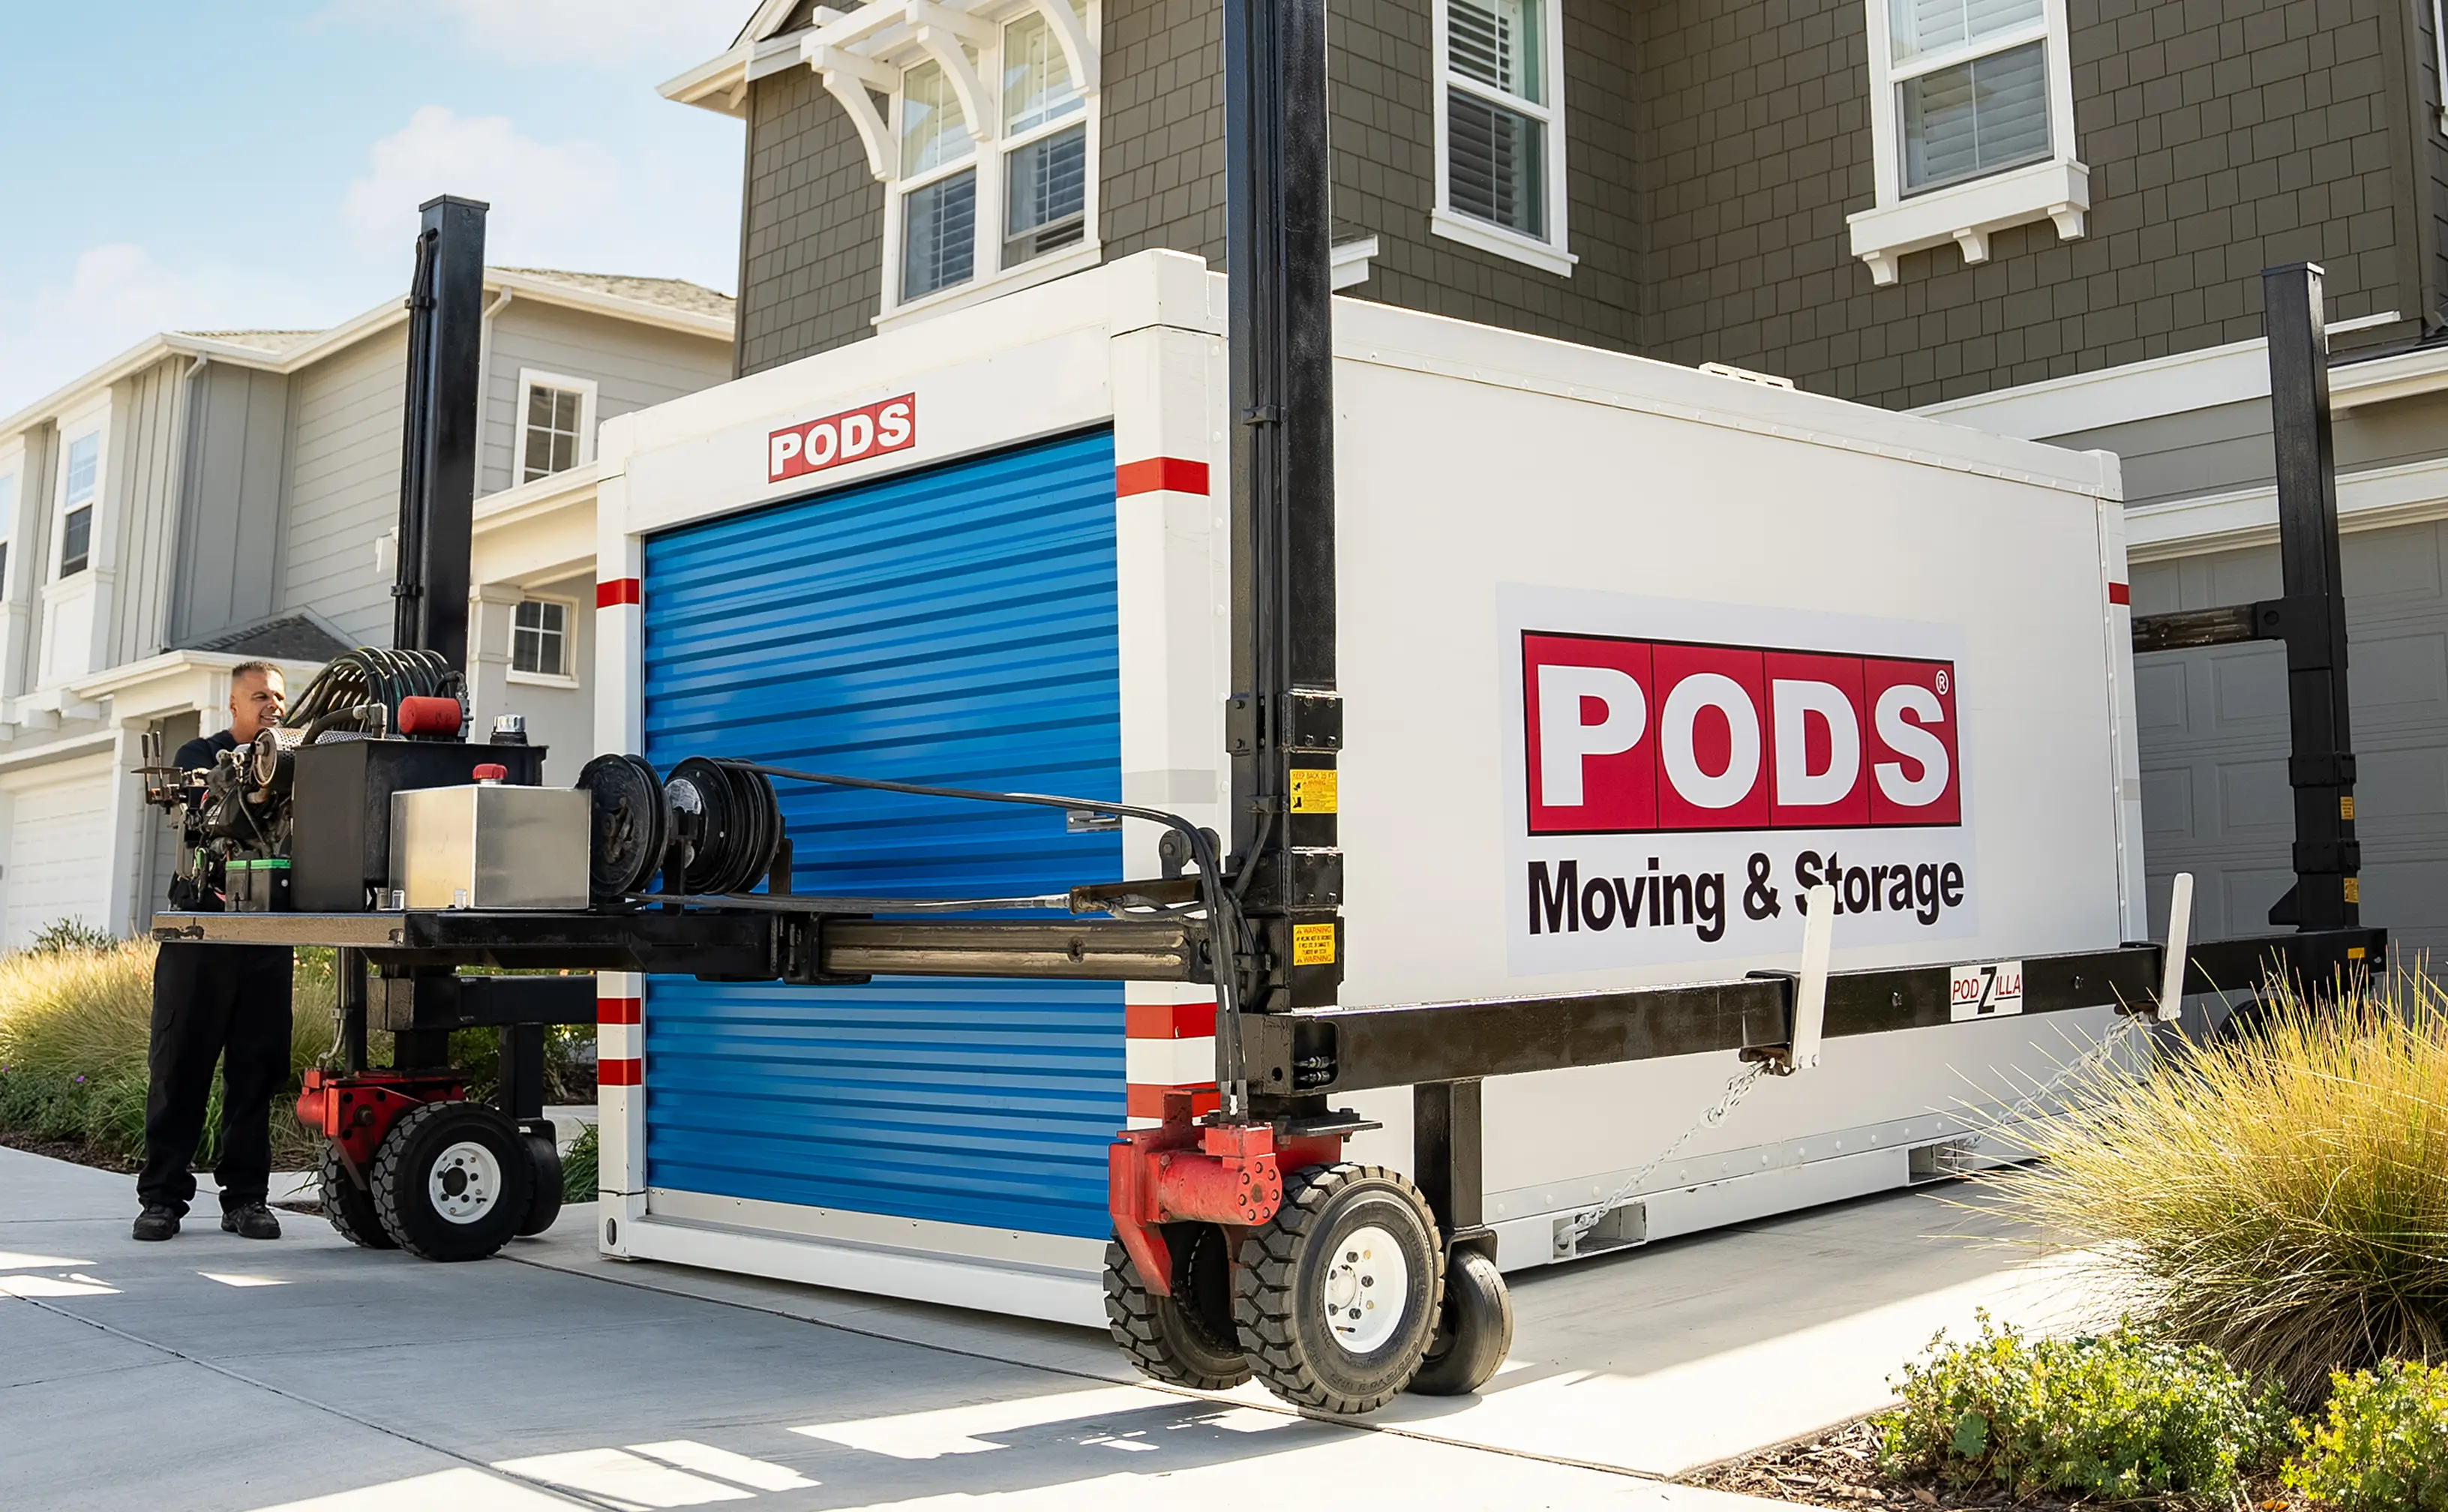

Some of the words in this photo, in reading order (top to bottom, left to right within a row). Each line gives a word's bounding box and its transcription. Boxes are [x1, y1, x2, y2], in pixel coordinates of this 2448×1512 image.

[771, 402, 911, 476] PODS
[1527, 856, 1726, 943] Moving
[1742, 851, 1782, 922] &
[1795, 849, 1964, 926] Storage
[1304, 926, 1332, 934] WARNING
[1304, 954, 1332, 963] WARNING
